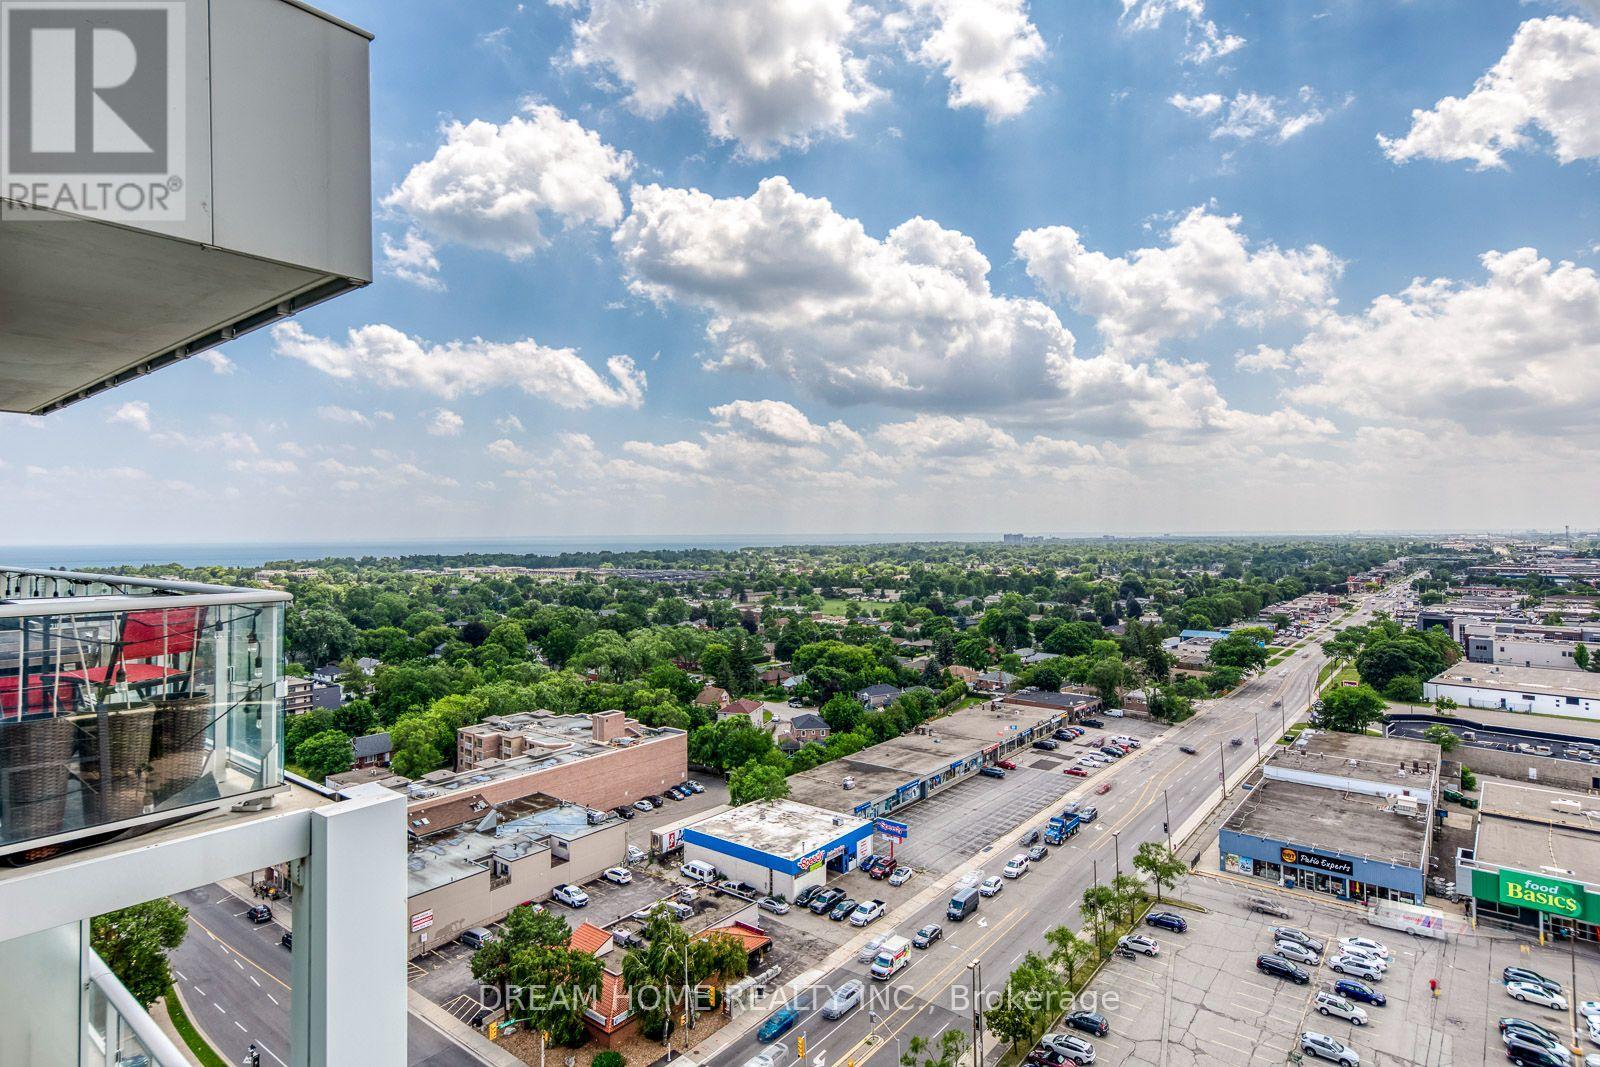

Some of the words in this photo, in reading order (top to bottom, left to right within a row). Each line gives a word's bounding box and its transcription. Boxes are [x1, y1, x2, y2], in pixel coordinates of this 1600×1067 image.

[798, 849, 825, 870] Speedy
[1299, 854, 1320, 866] Patio
[1321, 859, 1351, 873] Experts
[1524, 880, 1559, 895] food
